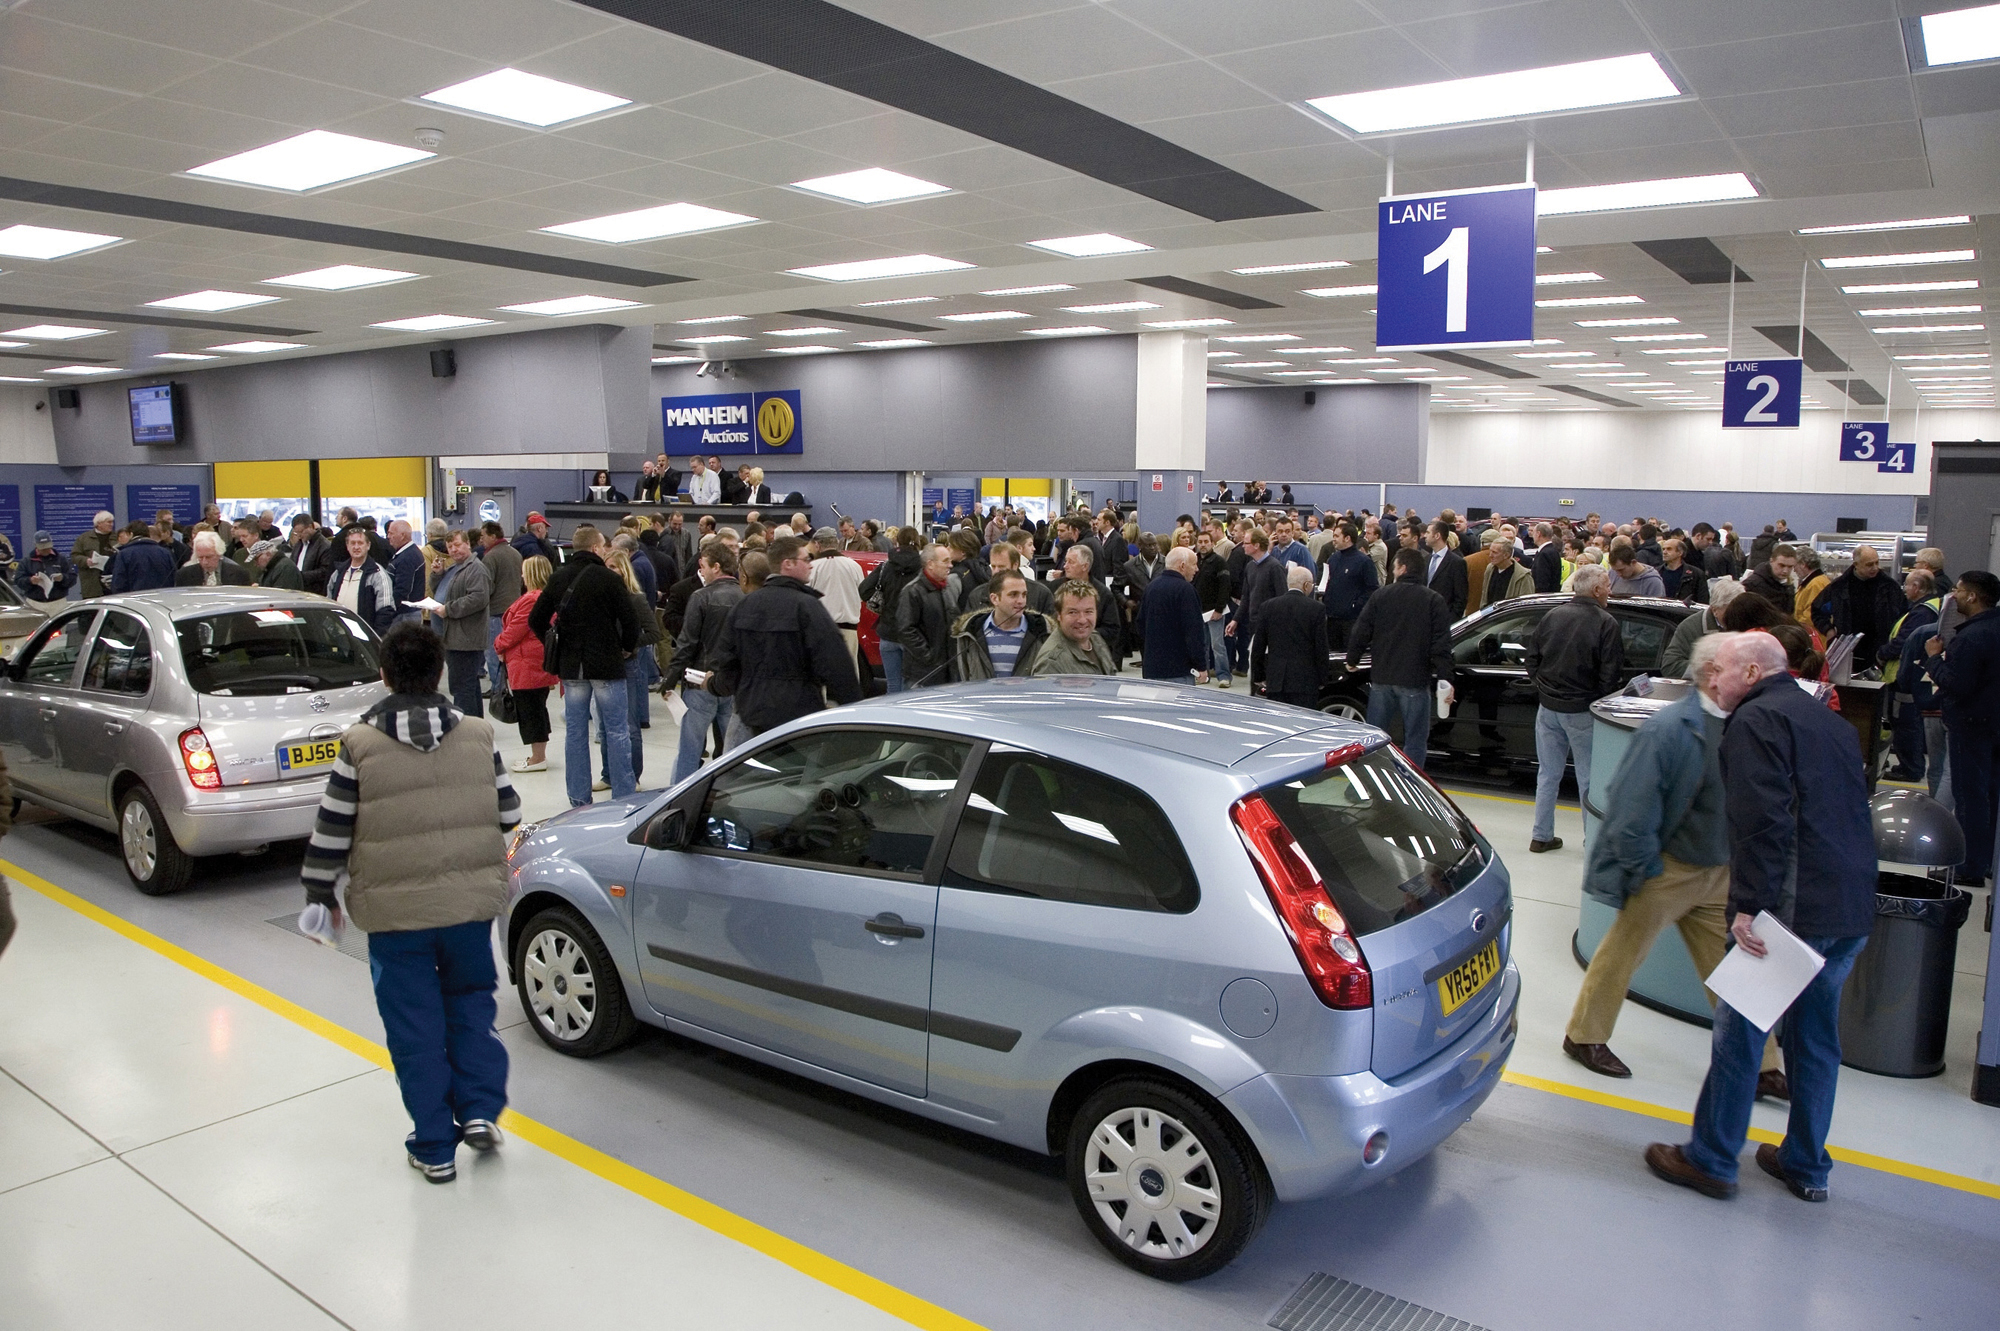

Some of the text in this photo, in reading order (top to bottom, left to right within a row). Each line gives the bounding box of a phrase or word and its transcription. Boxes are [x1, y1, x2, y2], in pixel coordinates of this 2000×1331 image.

[1389, 202, 1447, 225] LANE
[1423, 227, 1469, 333] 1
[1728, 363, 1759, 372] LANE
[1743, 375, 1780, 422] 2
[666, 405, 748, 427] MANHEIM
[701, 429, 749, 443] Auctions
[1854, 431, 1875, 460] 3
[1888, 449, 1906, 471] 4
[292, 743, 336, 764] BJ56
[1444, 941, 1496, 1005] YR56 FWY
[1144, 1177, 1159, 1189] Ford
